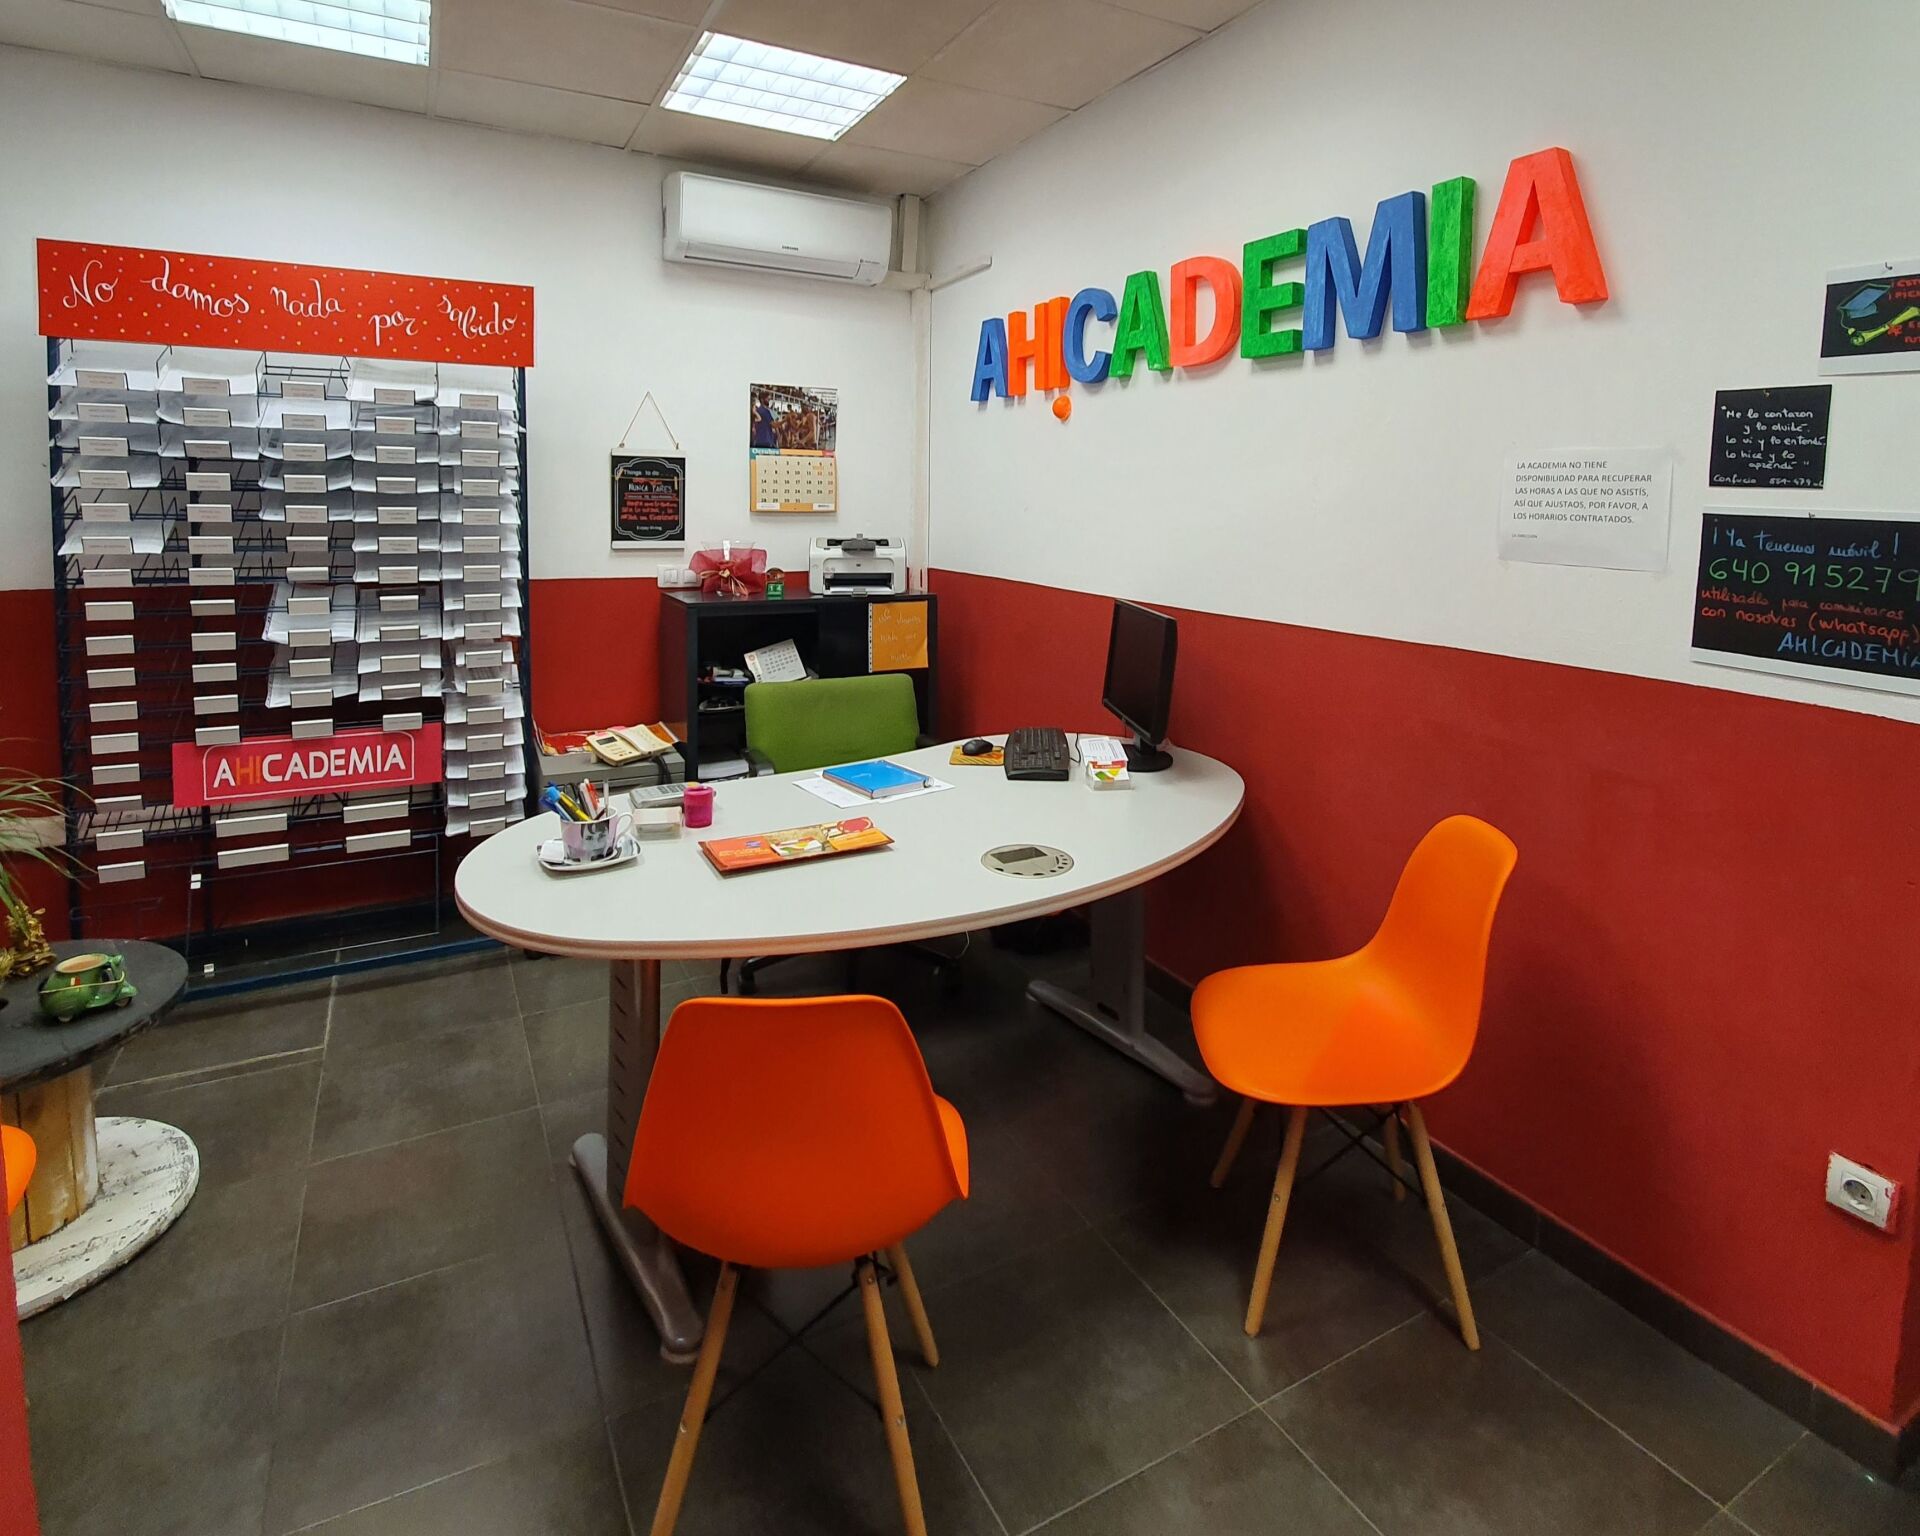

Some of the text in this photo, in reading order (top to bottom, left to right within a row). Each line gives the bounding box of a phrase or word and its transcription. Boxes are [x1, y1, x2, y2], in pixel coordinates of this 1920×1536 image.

[62, 256, 518, 346] No damos nada por sabido
[1747, 408, 1759, 419] lo
[1764, 408, 1813, 418] contaron
[1743, 424, 1750, 435] y
[1756, 421, 1767, 431] lo
[1758, 439, 1765, 452] y
[1770, 435, 1781, 445] lo
[1741, 450, 1762, 459] hice
[1769, 453, 1775, 463] y
[1782, 450, 1795, 459] lo
[1517, 460, 1608, 470] LA ACADEMIA NO TIENE
[1515, 474, 1652, 482] DISPONIBILIDAD PARA RECUPERAR
[1713, 474, 1757, 484] Confucio
[1515, 487, 1528, 495] LAS
[1529, 487, 1555, 495] HORAS
[1564, 488, 1578, 496] LAS
[1580, 488, 1599, 496] QUE
[1600, 488, 1614, 496] NO
[1615, 486, 1650, 497] ASISTÍS,
[1513, 498, 1649, 511] ASÍ QUE AJUSTAOS, POR FAVOR, A
[1513, 512, 1634, 524] LOS HORARIOS CONTRATADOS.
[1753, 530, 1816, 555] tenemos
[1709, 558, 1770, 584] 640
[1701, 586, 1769, 606] utilizadlo
[1782, 598, 1809, 615] para
[1701, 607, 1726, 619] con
[1735, 608, 1797, 628] nosotras
